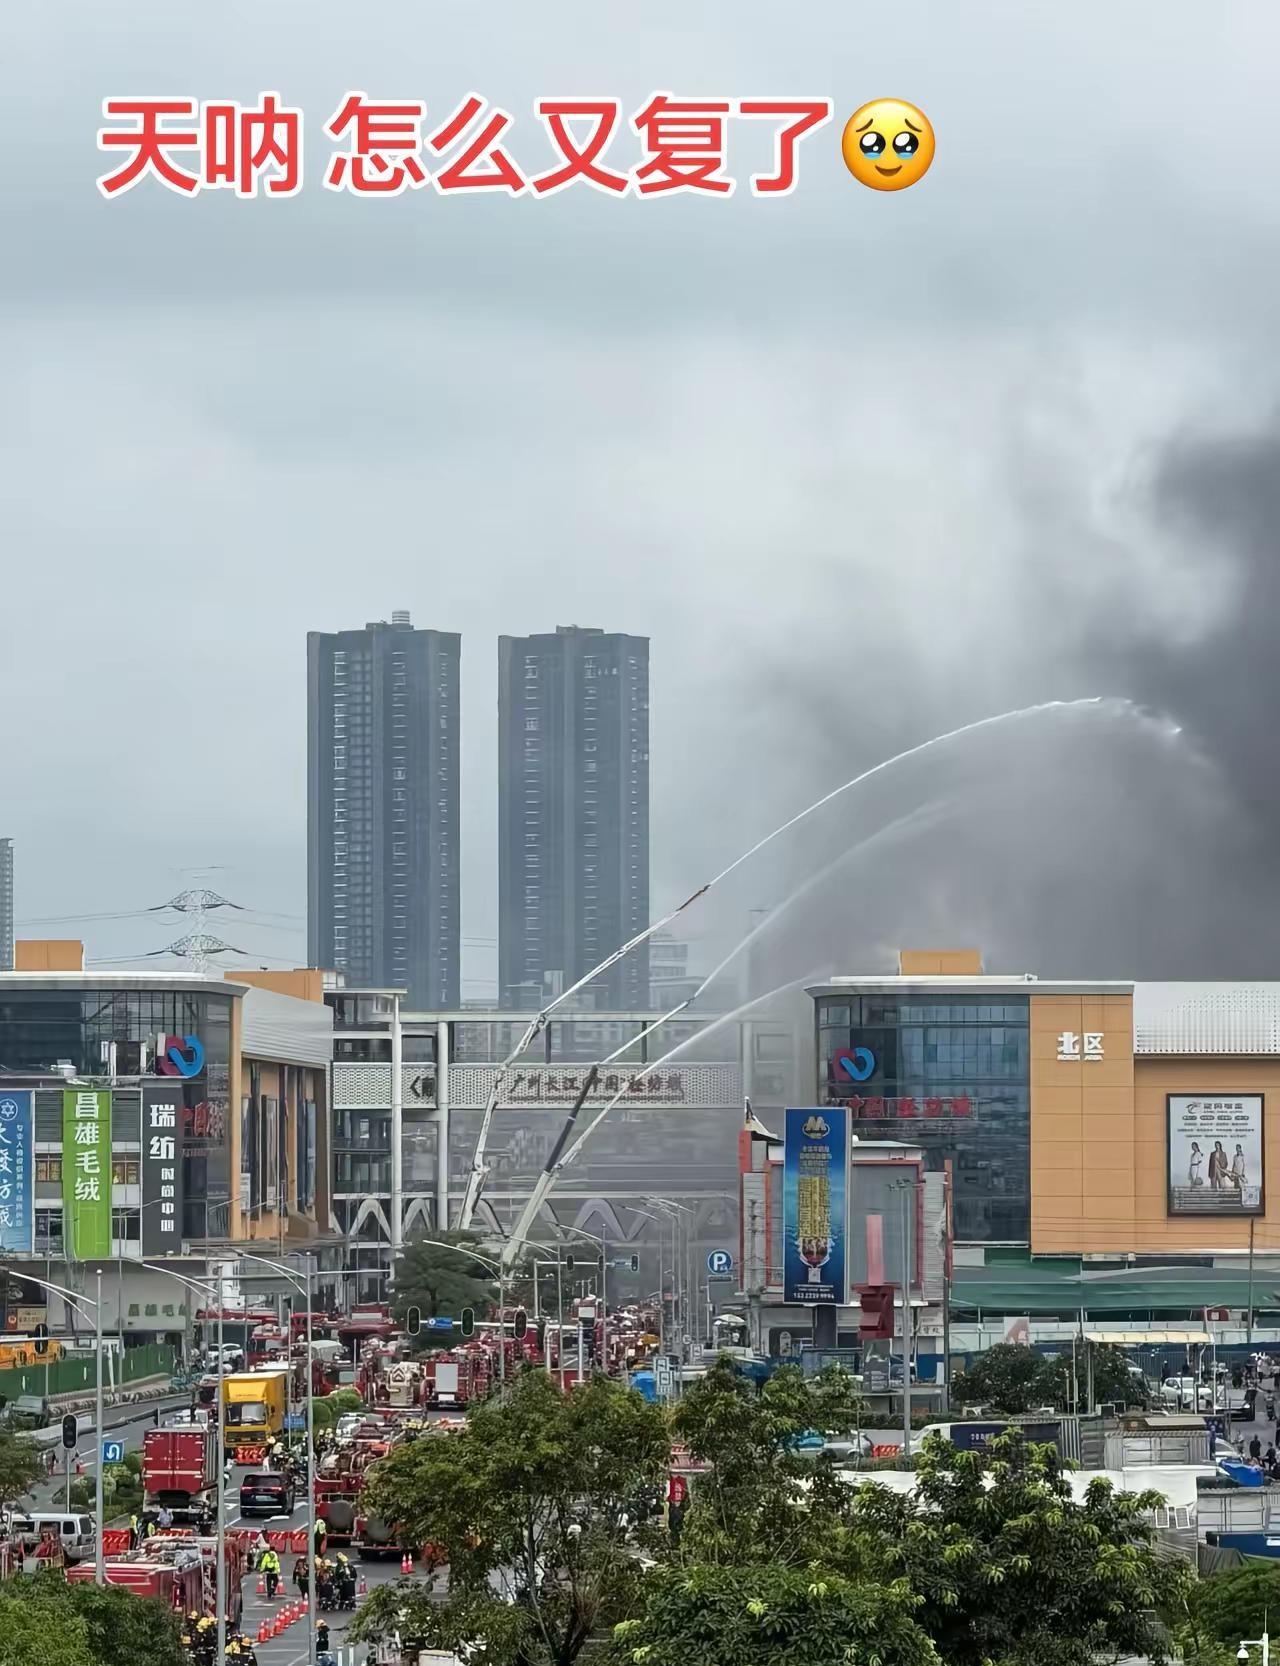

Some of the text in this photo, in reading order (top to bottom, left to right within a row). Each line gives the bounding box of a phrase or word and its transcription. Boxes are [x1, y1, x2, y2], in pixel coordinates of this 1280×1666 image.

[1057, 1031, 1104, 1054] 北区
[74, 1092, 100, 1201] 昌雄毛绒
[713, 1253, 727, 1271] P
